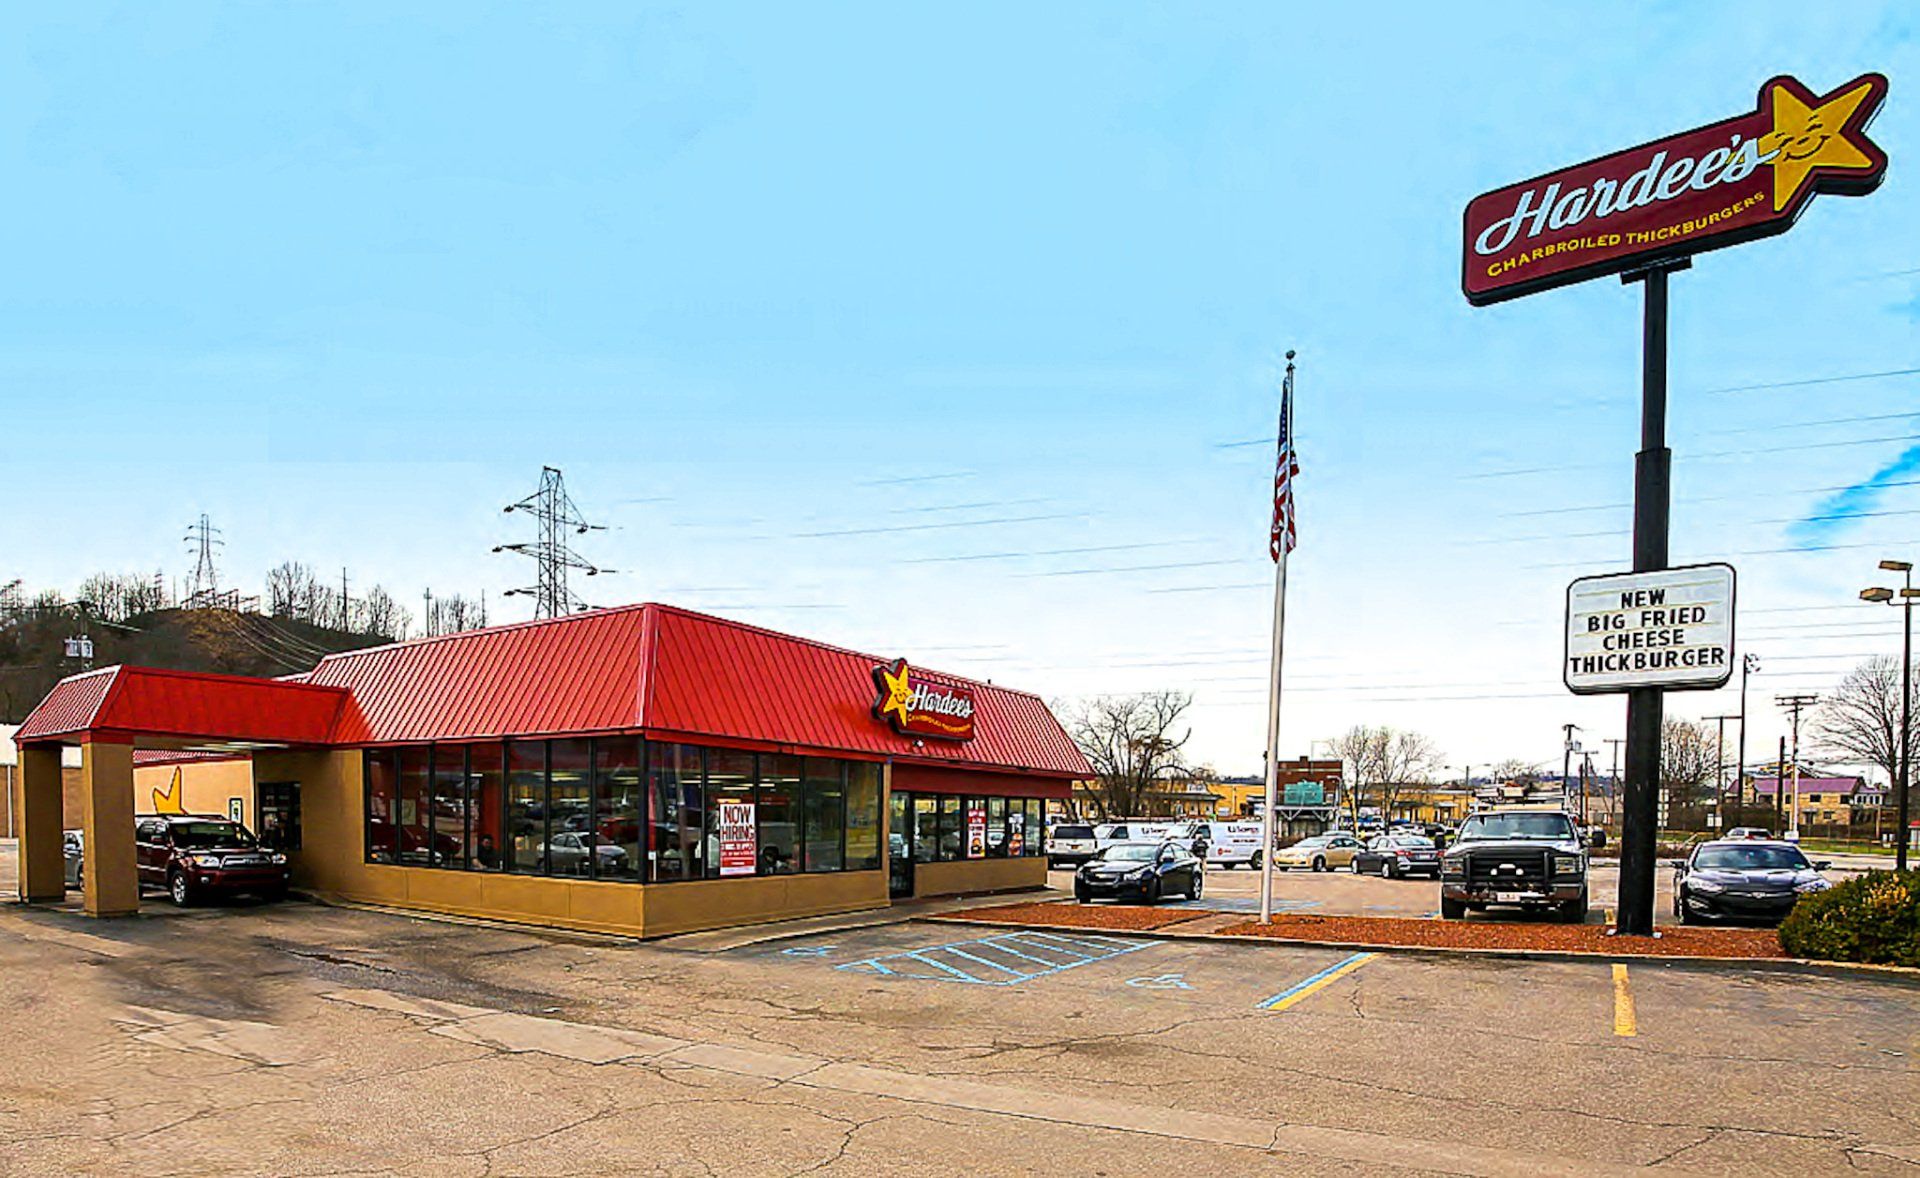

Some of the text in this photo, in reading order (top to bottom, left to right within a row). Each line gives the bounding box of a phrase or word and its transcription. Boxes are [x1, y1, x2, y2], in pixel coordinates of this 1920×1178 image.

[1474, 134, 1781, 255] Hardee's
[1487, 191, 1765, 277] CHARBROILED THICKBURGERS
[1621, 589, 1665, 609] NEW
[1588, 607, 1705, 632] BIG FRIED
[1603, 629, 1684, 650] CHEESE
[1570, 647, 1724, 673] THICKBURGER
[724, 806, 751, 824] NOW
[721, 825, 755, 841] HIRING
